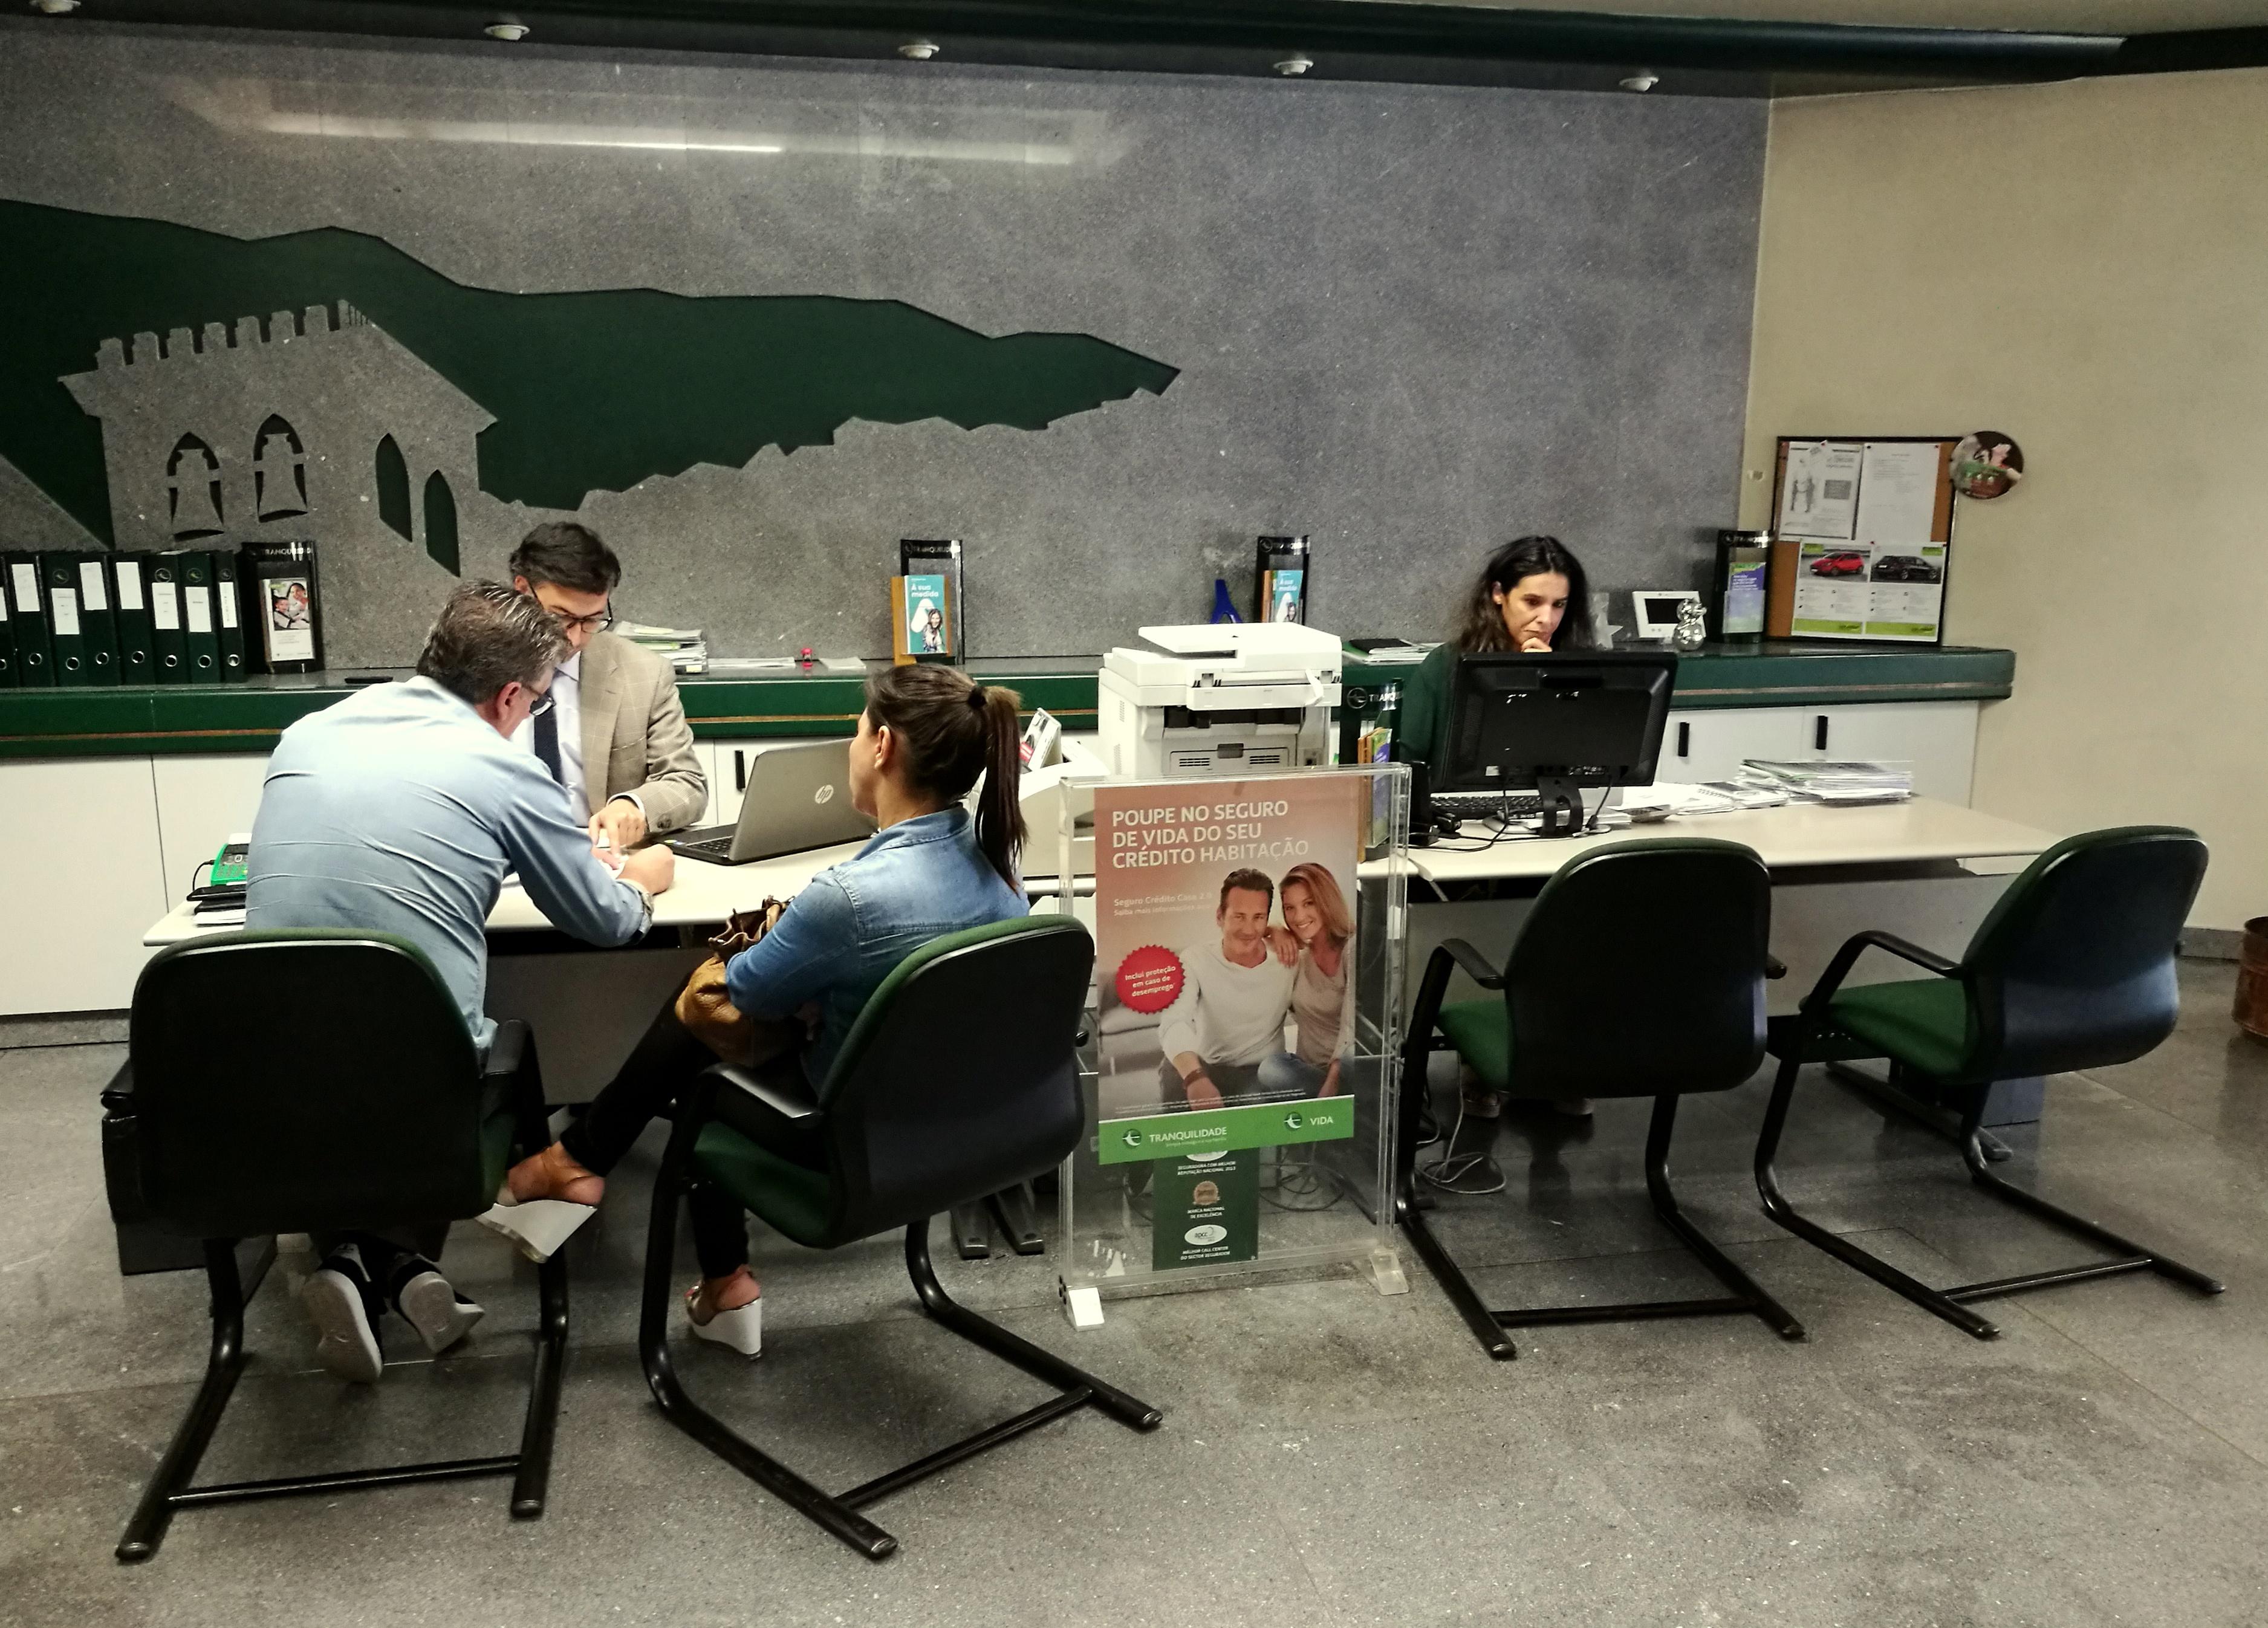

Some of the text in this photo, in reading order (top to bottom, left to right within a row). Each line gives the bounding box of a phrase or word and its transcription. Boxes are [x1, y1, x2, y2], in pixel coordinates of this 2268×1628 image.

[1113, 800, 1288, 826] POUPE NO SEGURO
[1113, 823, 1262, 848] DE VIDA DO SEU
[1113, 837, 1308, 868] CRÉDITO HABITAÇÃO
[1114, 899, 1143, 907] Seguro
[1145, 895, 1175, 904] Crédito
[1125, 965, 1176, 981] Inclui proteção
[1310, 1116, 1334, 1126] VIDA
[1149, 1127, 1227, 1143] TRANQUILIDADE
